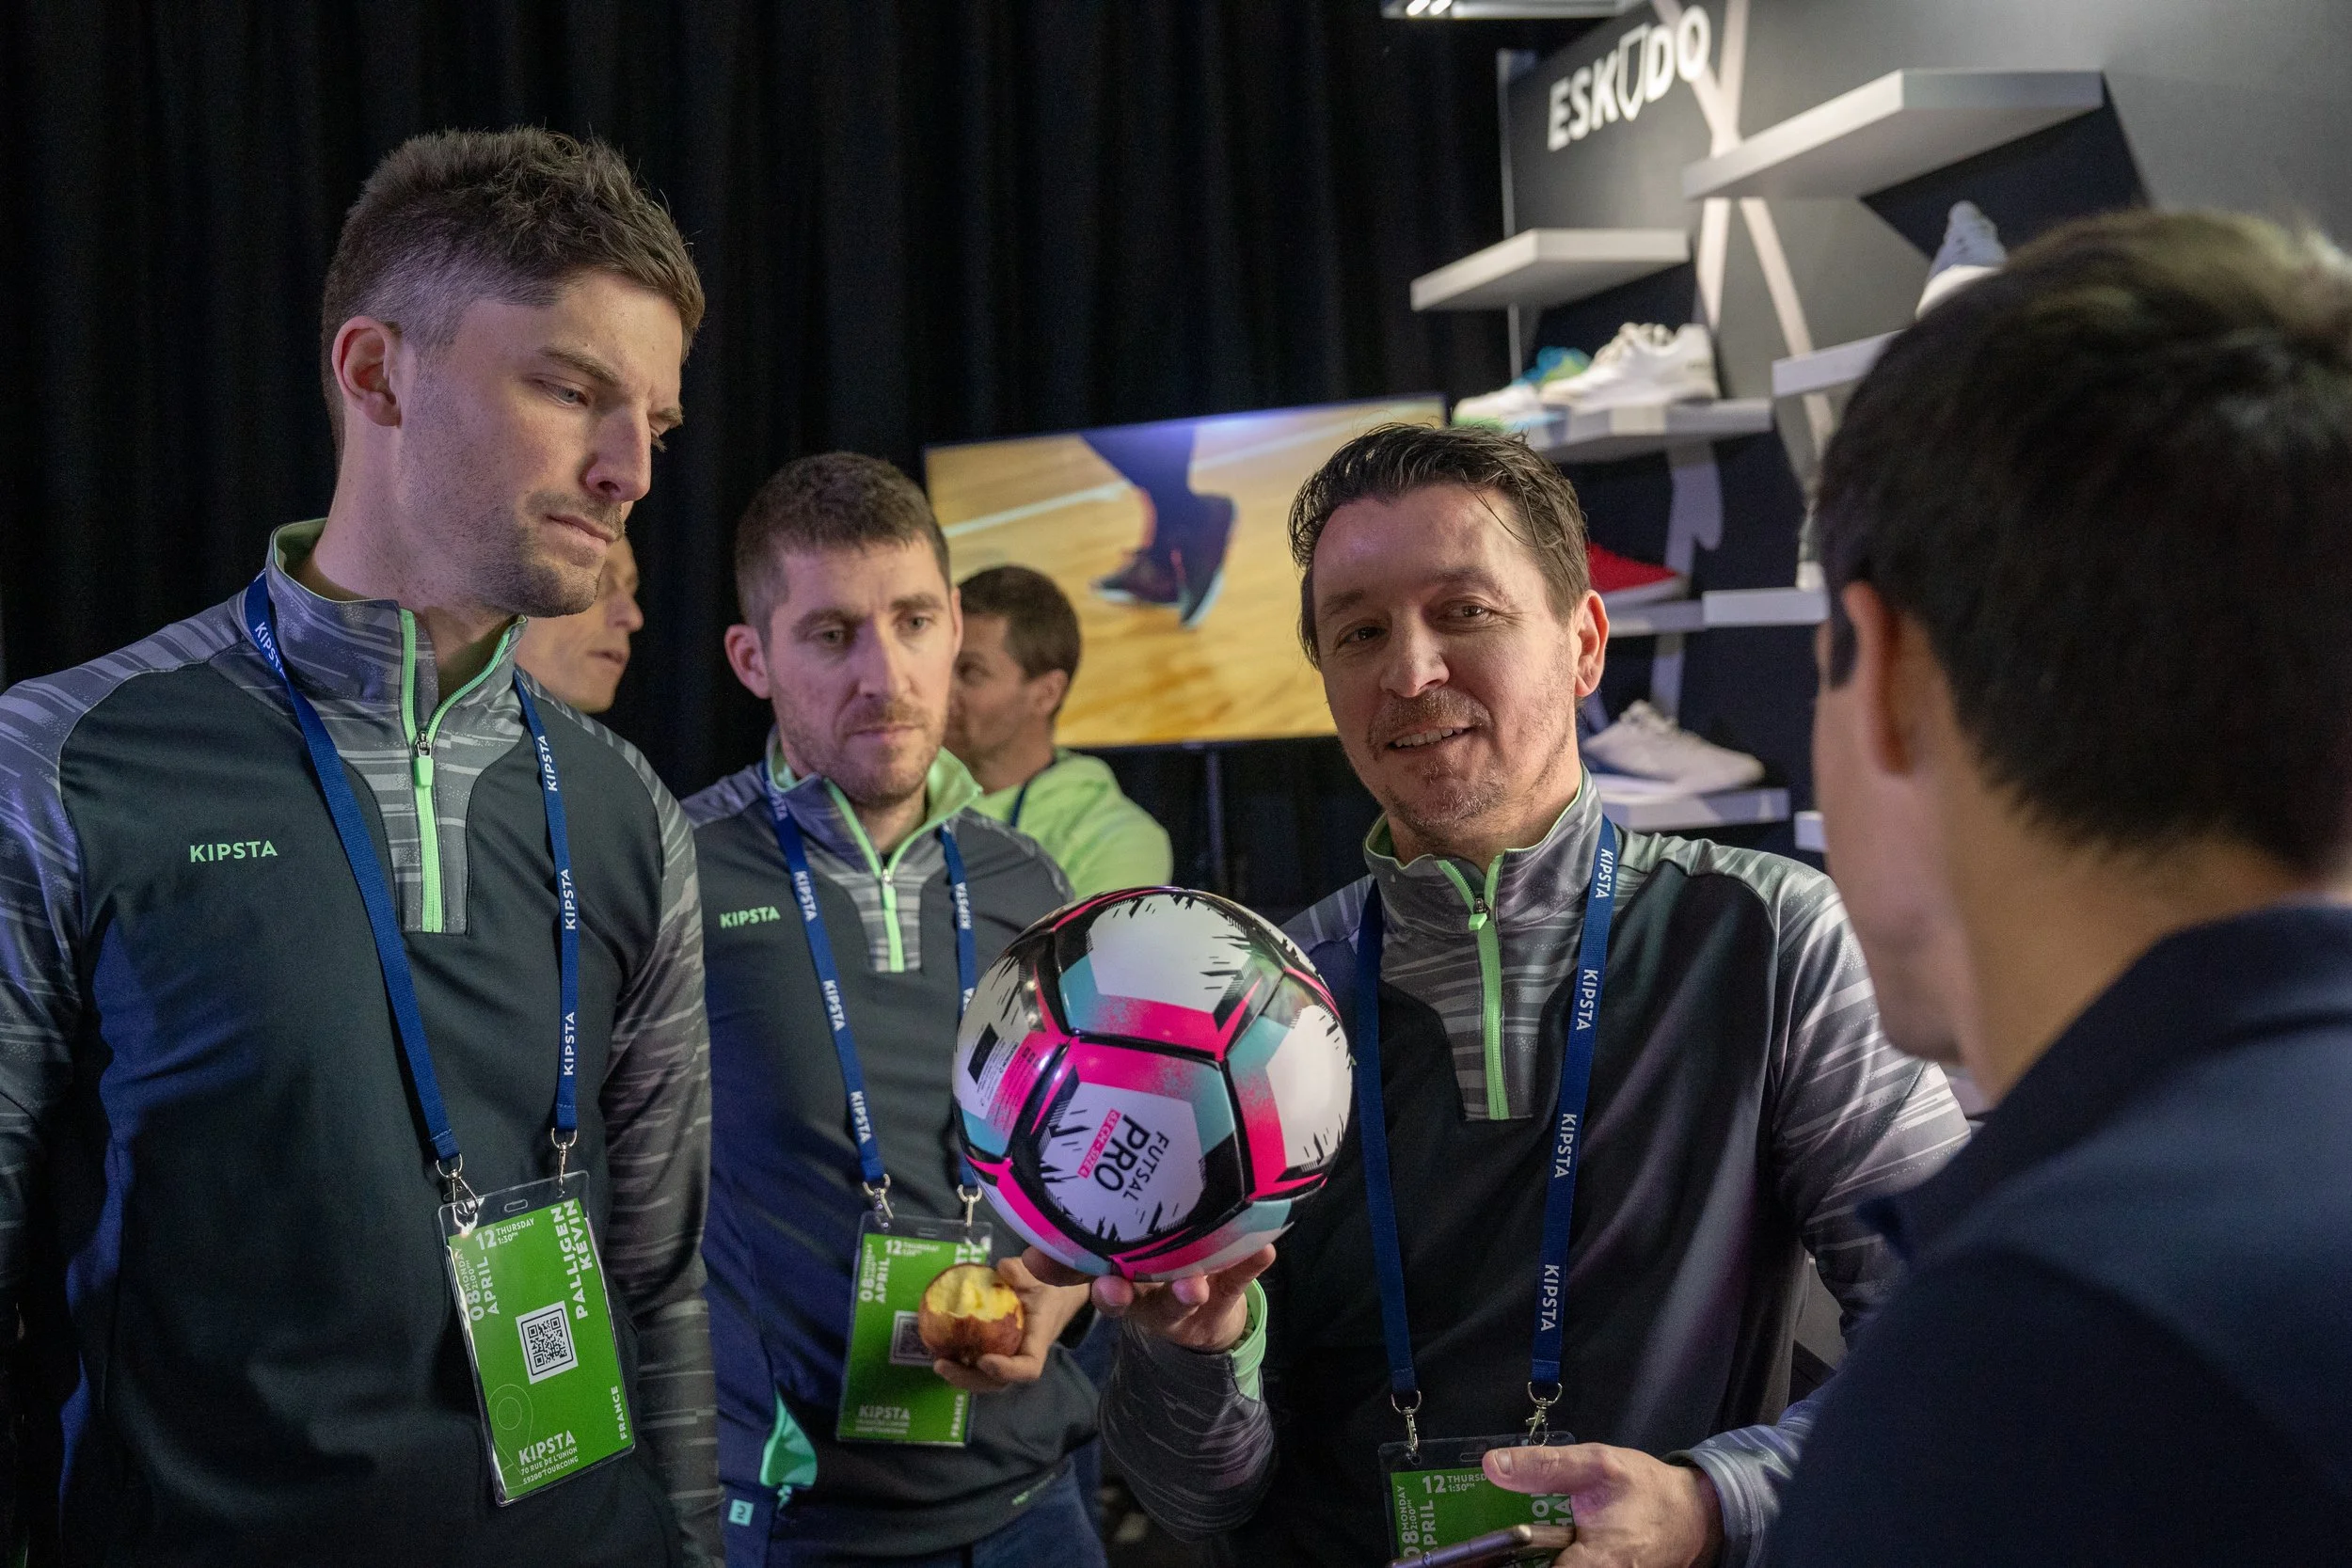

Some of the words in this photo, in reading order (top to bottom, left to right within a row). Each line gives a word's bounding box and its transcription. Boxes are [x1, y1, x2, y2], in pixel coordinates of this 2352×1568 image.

[1548, 5, 1710, 151] ESKUDO
[538, 735, 558, 792] KIPSTA
[189, 840, 278, 863] KIPSTA
[1594, 847, 1613, 900] KIPSTA
[561, 868, 578, 930] KIPSTA
[720, 906, 781, 928] KIPSTA
[794, 871, 818, 922] KIPSTA
[821, 979, 846, 1032] KIPSTA
[1576, 969, 1598, 1032] KIPSTA
[564, 1012, 576, 1076] KIPSTA
[850, 1090, 871, 1145] KIPSTA
[1093, 1114, 1151, 1192] PRO
[1122, 1131, 1169, 1201] FUTSAL
[1554, 1113, 1578, 1179] KIPSTA
[475, 1229, 497, 1250] 12
[496, 1217, 534, 1236] THURSDAY
[884, 1239, 902, 1256] 12
[477, 1256, 500, 1315] APRIL
[550, 1207, 589, 1320] PALLIGEN
[875, 1257, 891, 1304] APRIL
[466, 1290, 484, 1321] 08
[1540, 1263, 1560, 1333] KIPSTA
[611, 1386, 628, 1440] FRANCE
[518, 1430, 576, 1465] KIPSTA
[530, 1463, 543, 1472] RUE
[541, 1455, 579, 1476] TOURCOING
[1397, 1485, 1409, 1531] MONDAY
[1422, 1474, 1447, 1494] 12
[1447, 1473, 1486, 1483] THURSD
[1420, 1499, 1438, 1545] PRIL
